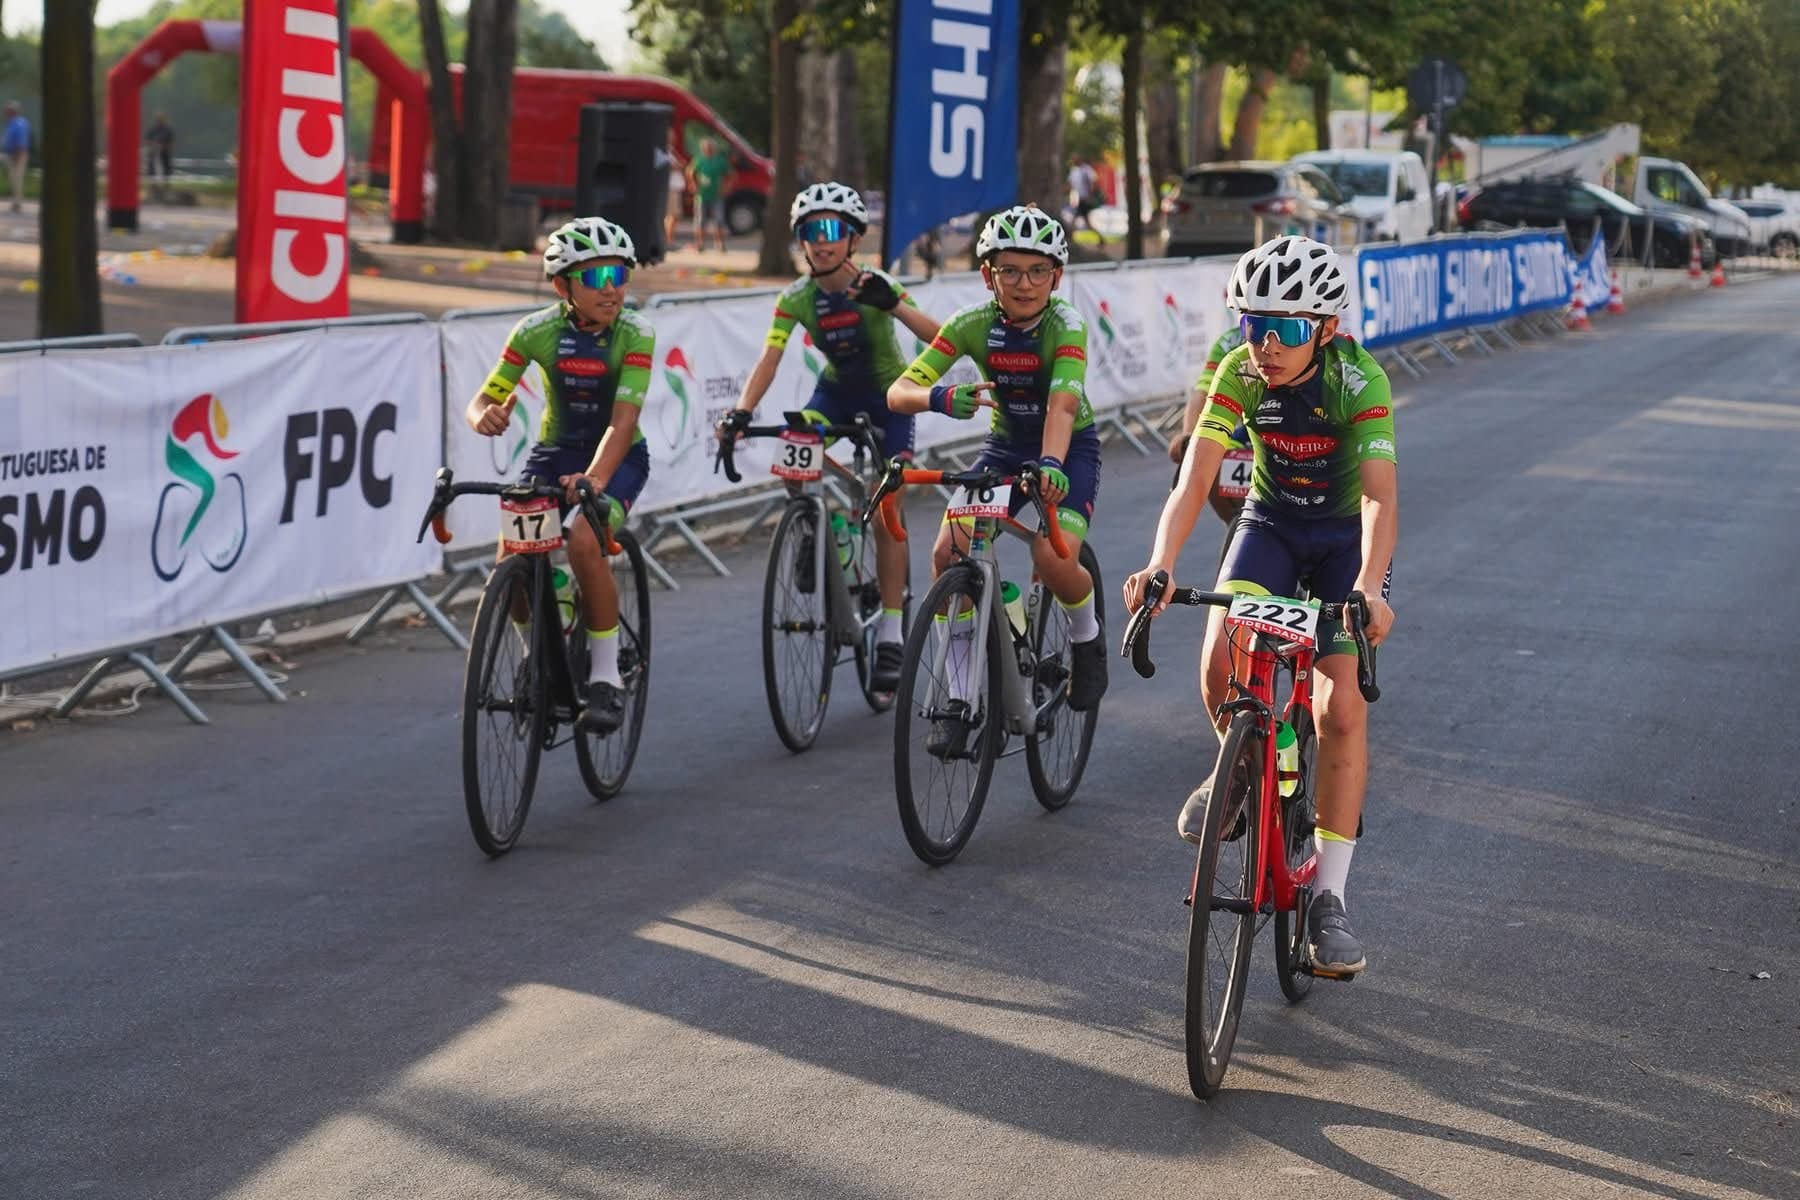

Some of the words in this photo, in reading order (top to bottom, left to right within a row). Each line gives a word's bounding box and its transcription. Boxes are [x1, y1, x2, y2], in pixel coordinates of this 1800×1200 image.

[271, 6, 345, 304] CICLI
[1362, 253, 1440, 340] SHIMANO
[1444, 247, 1513, 320] SHIMANO
[85, 445, 107, 471] DE
[279, 402, 398, 524] FPC
[782, 443, 814, 469] 39
[0, 484, 107, 576] SMO
[512, 513, 546, 541] 17
[1237, 602, 1309, 633] 222
